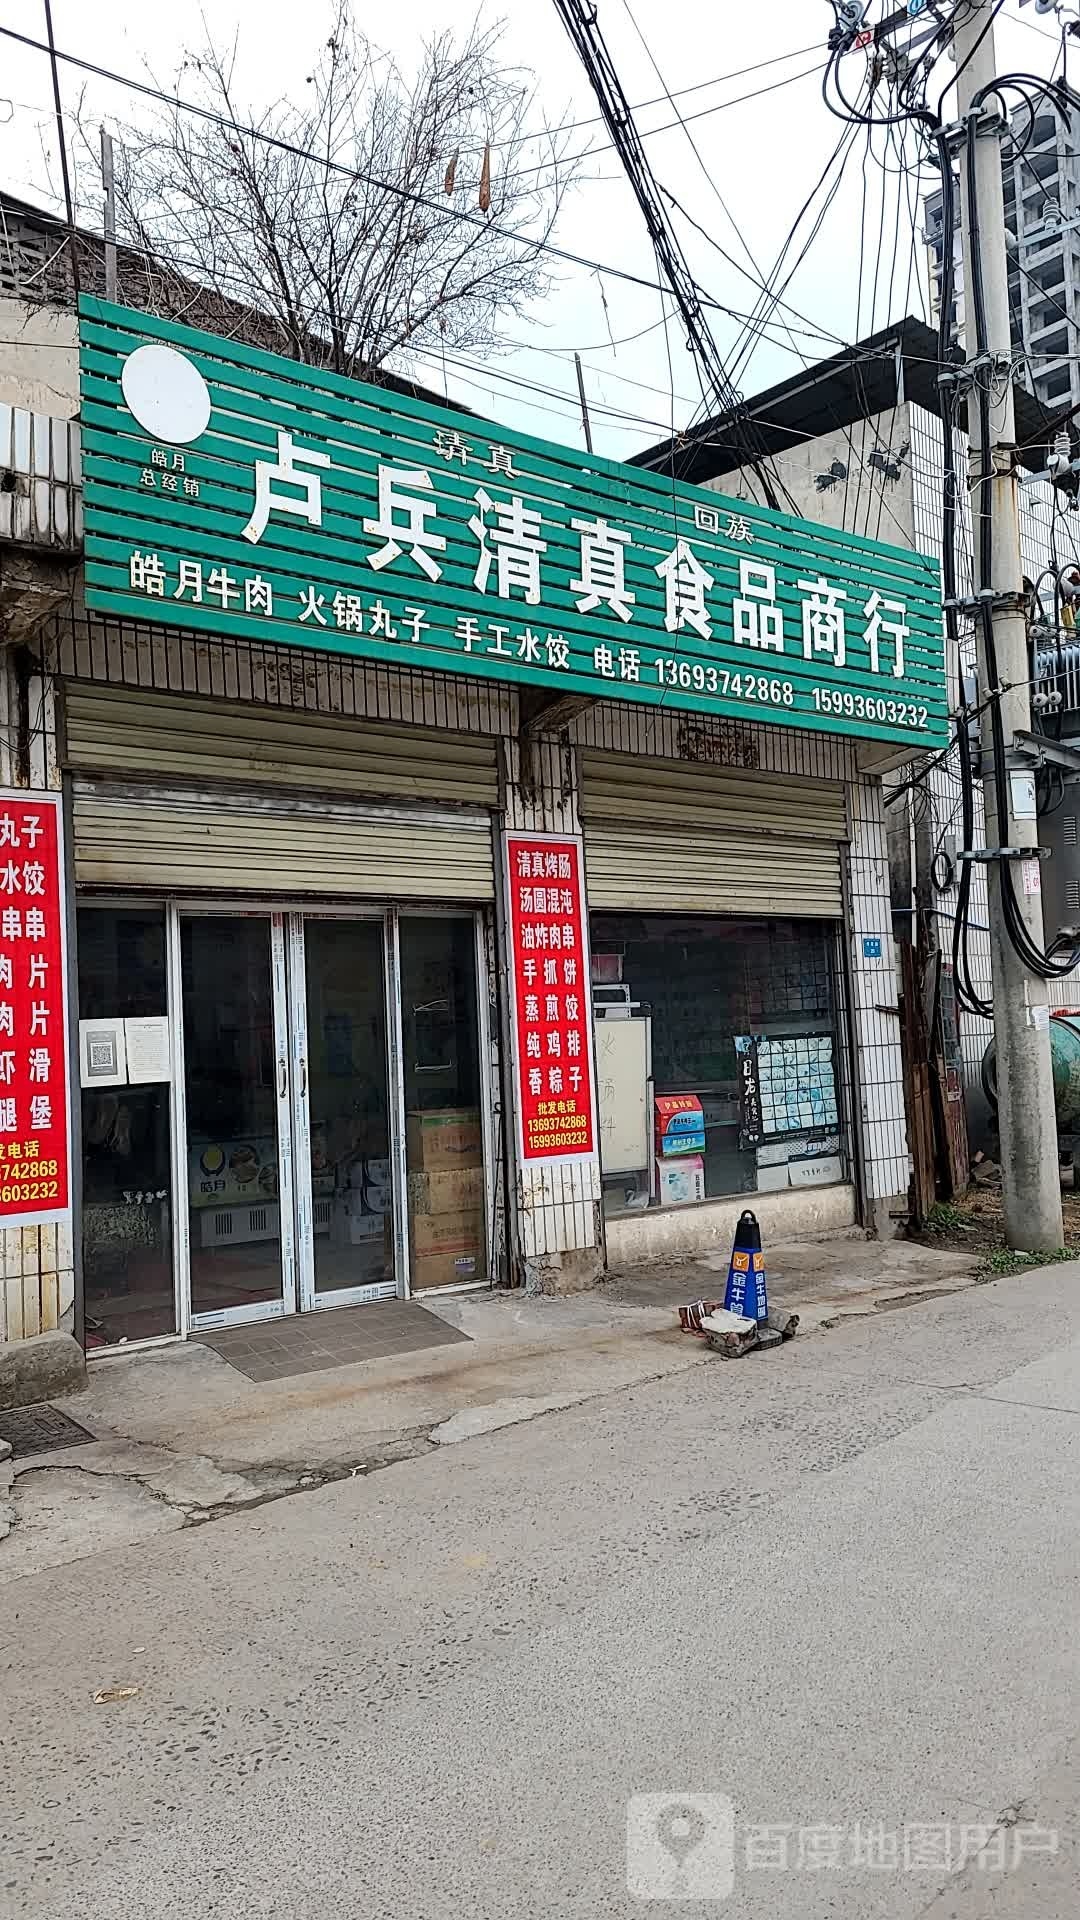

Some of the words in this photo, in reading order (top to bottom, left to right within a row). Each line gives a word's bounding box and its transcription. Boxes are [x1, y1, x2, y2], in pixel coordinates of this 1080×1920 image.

[151, 448, 186, 472] 皓月
[139, 468, 200, 496] 总经销
[693, 505, 754, 544] 回族
[240, 431, 909, 679] 卢兵清真食品商行
[130, 551, 274, 616] 皓月牛肉
[298, 586, 431, 643] 火锅丸子
[455, 617, 571, 670] 手工水饺
[593, 644, 641, 682] 电话
[654, 658, 794, 706] 13693742868
[812, 687, 928, 729] 15993603232
[0, 813, 44, 848] 丸子
[0, 860, 46, 895] 水饺
[517, 850, 571, 879] 清真烤肠
[519, 887, 573, 915] 汤圆混沌
[2, 906, 46, 941] 串串
[521, 923, 575, 950] 油炸肉串
[523, 958, 577, 986] 手抓饼
[525, 994, 579, 1022] 蒸煎饺
[527, 1030, 581, 1059] 纯鸡排
[528, 1066, 582, 1096] 香粽子
[537, 1099, 576, 1116] 批发电话
[527, 1115, 587, 1133] 13693742868
[528, 1132, 588, 1150] 15993603232
[0, 1160, 58, 1180] 742868
[0, 1181, 58, 1202] 603232
